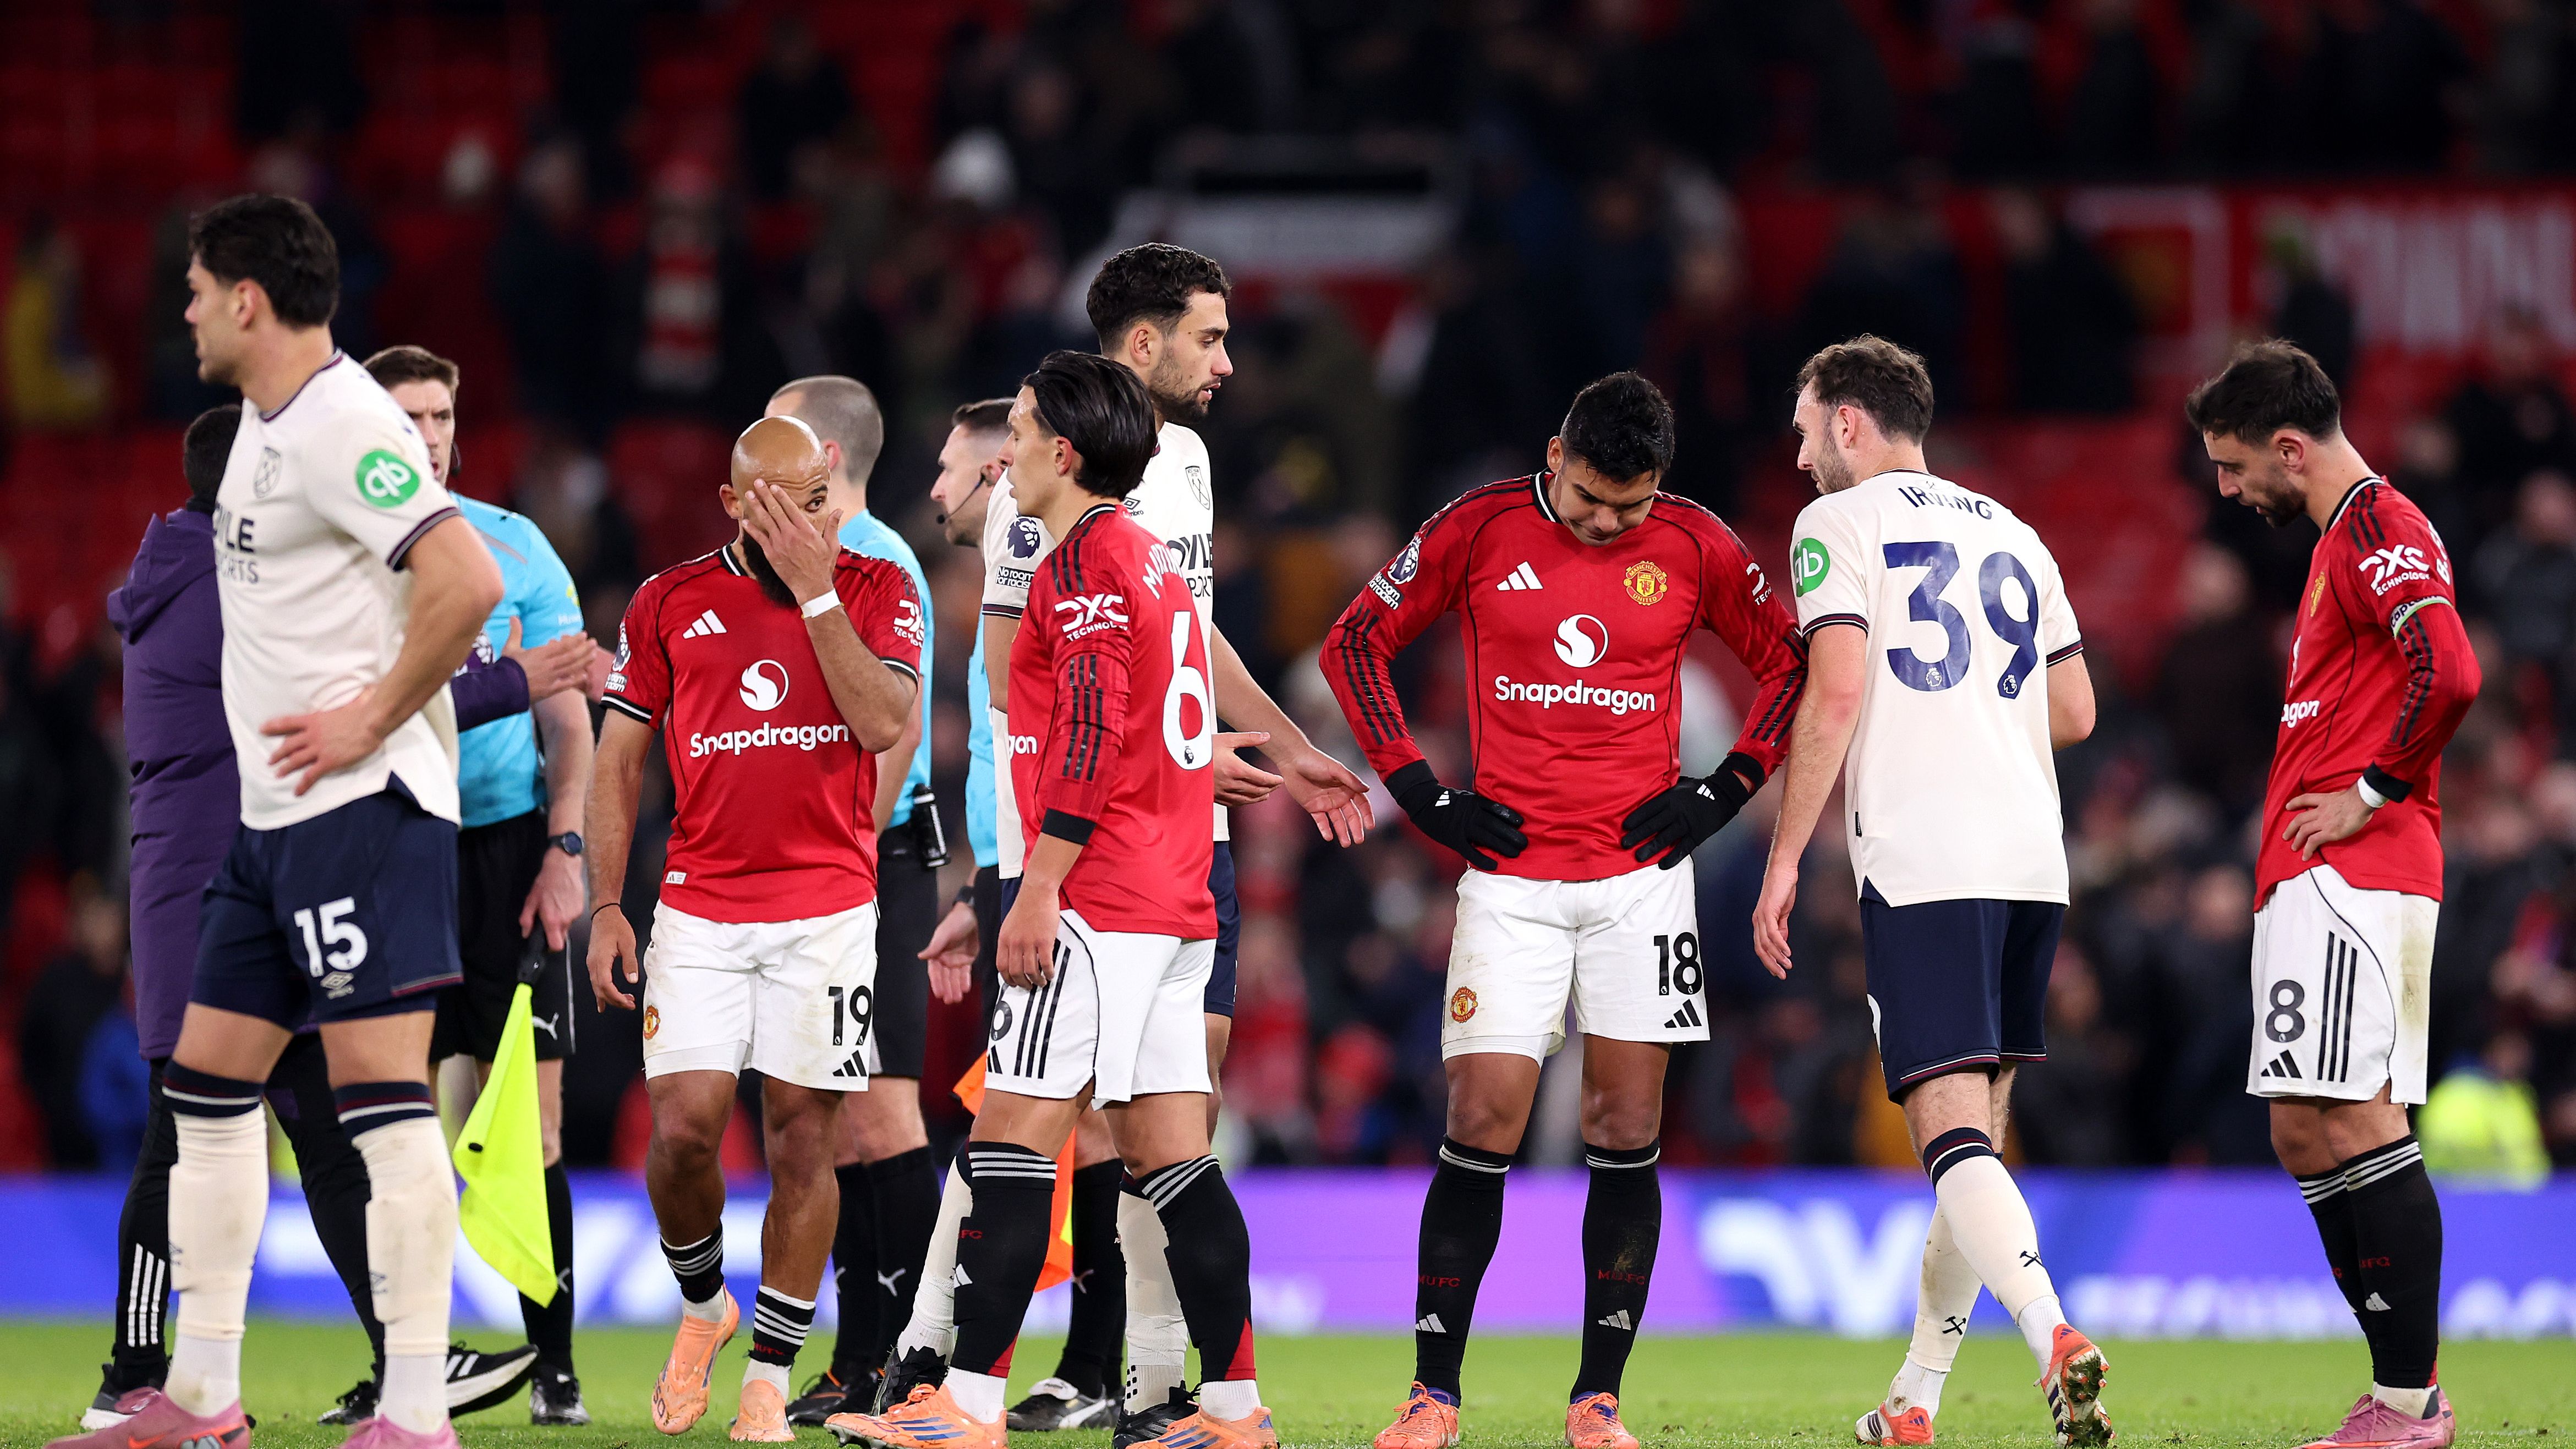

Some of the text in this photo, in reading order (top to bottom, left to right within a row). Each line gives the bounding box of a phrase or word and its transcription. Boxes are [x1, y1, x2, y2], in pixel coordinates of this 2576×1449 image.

[1898, 486, 1992, 520] IRVING
[997, 566, 1009, 578] No
[1629, 564, 1664, 581] MANCHESTER
[2358, 544, 2430, 590] DXC
[1378, 578, 1400, 601] room
[1632, 593, 1657, 603] UNITED
[1054, 593, 1129, 633] DXC
[1882, 541, 2039, 700] 39
[1162, 611, 1213, 771] 6
[1495, 676, 1655, 715] Snapdragon
[689, 722, 849, 758] Snapdragon
[294, 896, 368, 978] 15
[1653, 932, 1703, 996] 18
[828, 985, 873, 1046] 19
[2265, 979, 2305, 1043] 8
[1418, 1275, 1461, 1288] MUFC
[1598, 1267, 1646, 1286] MUFC
